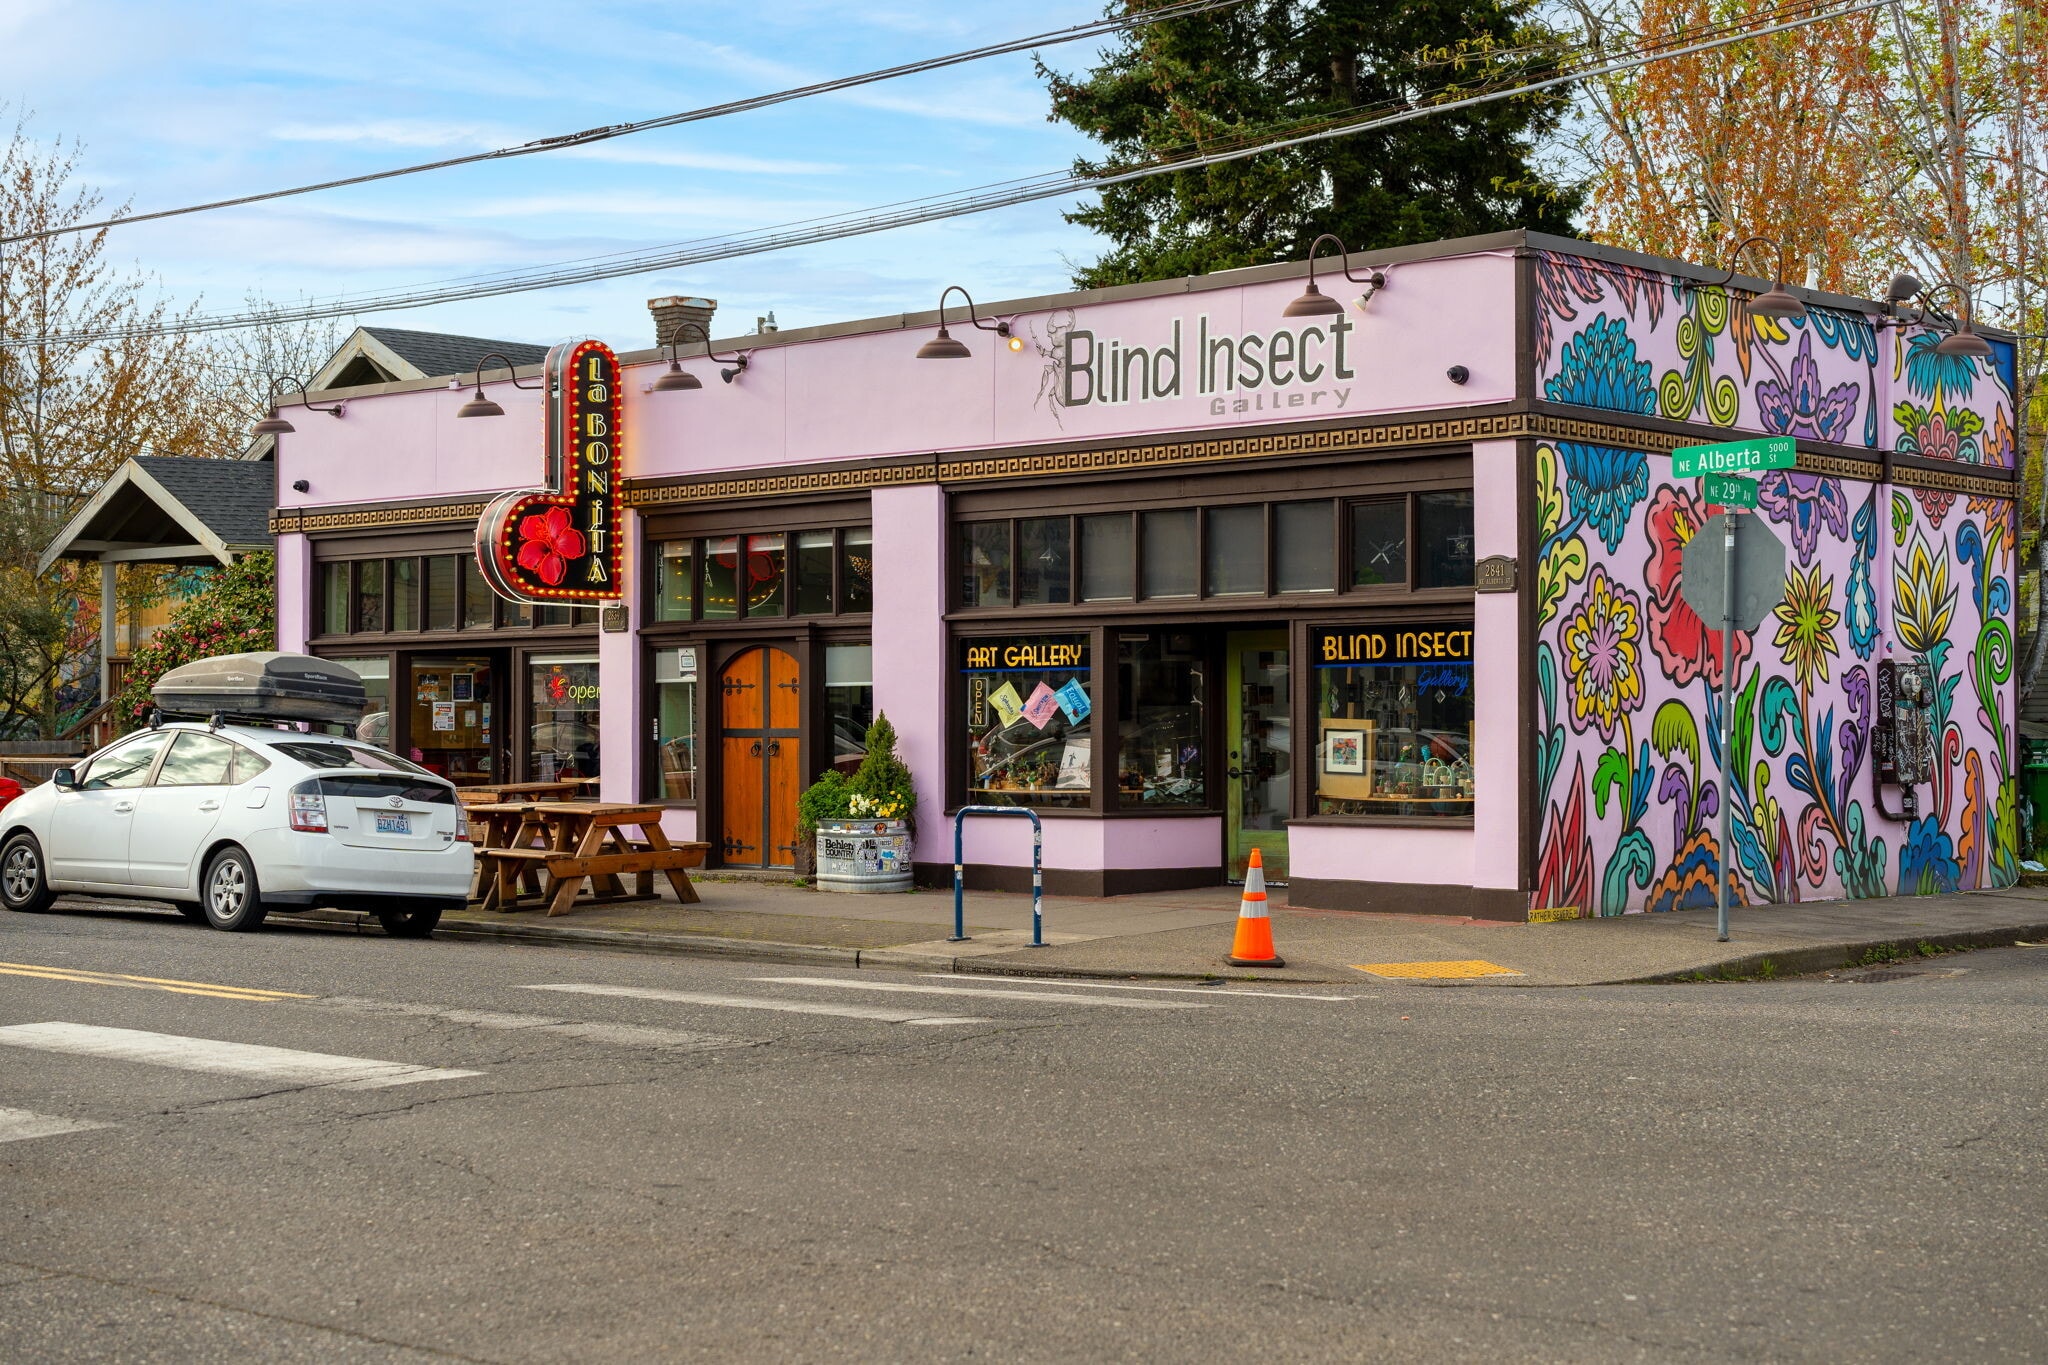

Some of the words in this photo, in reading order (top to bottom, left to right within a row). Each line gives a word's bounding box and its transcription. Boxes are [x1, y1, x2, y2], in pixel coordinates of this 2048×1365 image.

[1065, 318, 1182, 407] Blind
[1198, 312, 1355, 395] Insect
[1209, 387, 1352, 416] Gallery
[1768, 442, 1789, 453] 5000
[1679, 460, 1691, 472] NE
[1697, 449, 1761, 471] Alberta
[1768, 454, 1777, 463] St
[1710, 485, 1719, 498] NE
[1722, 482, 1741, 500] 29th
[1743, 490, 1751, 501] Av
[1485, 563, 1505, 577] 2841
[967, 647, 998, 668] ART
[1004, 644, 1082, 667] GALLERY
[1322, 634, 1387, 661] BLIND
[1396, 631, 1473, 658] INSECT
[1417, 669, 1470, 696] Gallery
[974, 680, 983, 725] OPEN
[1066, 686, 1086, 713] Equal
[825, 838, 854, 851] Behlen
[825, 848, 854, 858] COUNTRY
